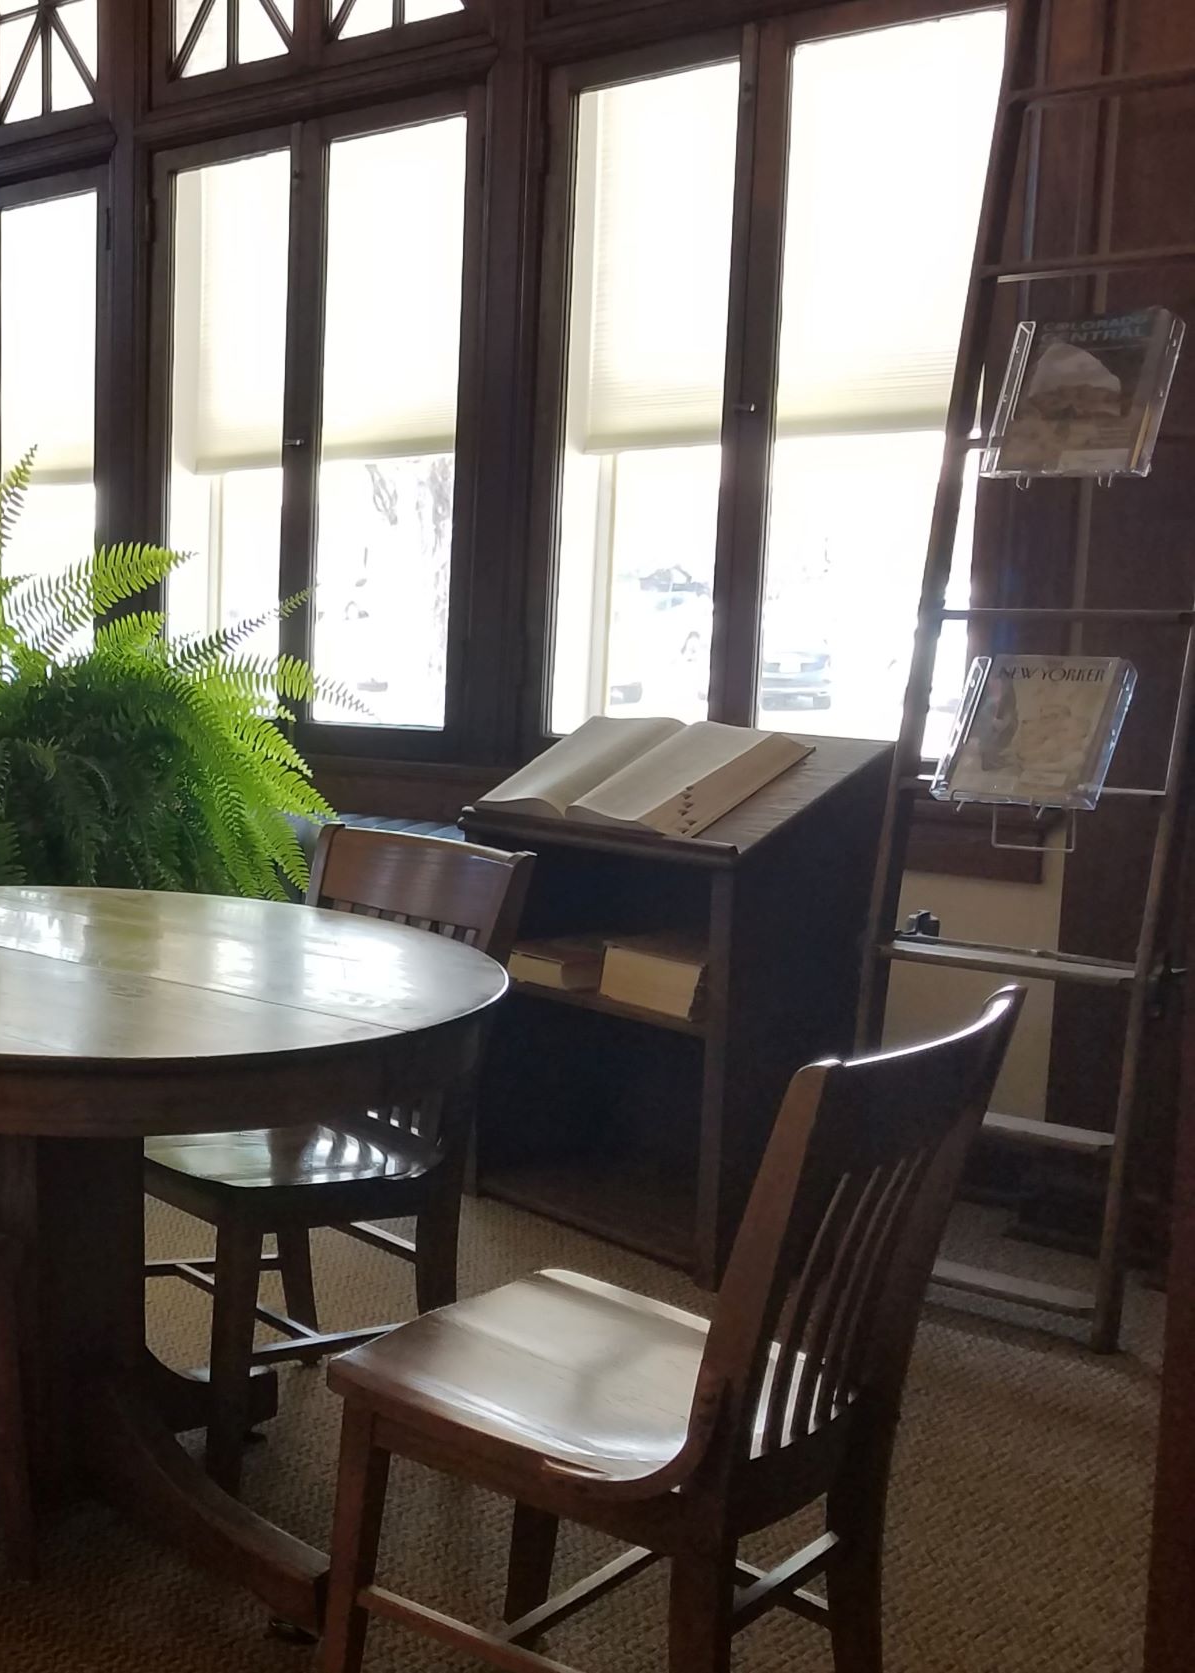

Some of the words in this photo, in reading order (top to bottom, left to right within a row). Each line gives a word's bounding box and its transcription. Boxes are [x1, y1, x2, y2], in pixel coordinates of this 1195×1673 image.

[1043, 315, 1149, 332] COLORADO
[1041, 327, 1144, 342] CENTRAL
[998, 667, 1039, 679] NEW
[1041, 668, 1106, 681] YORKER
